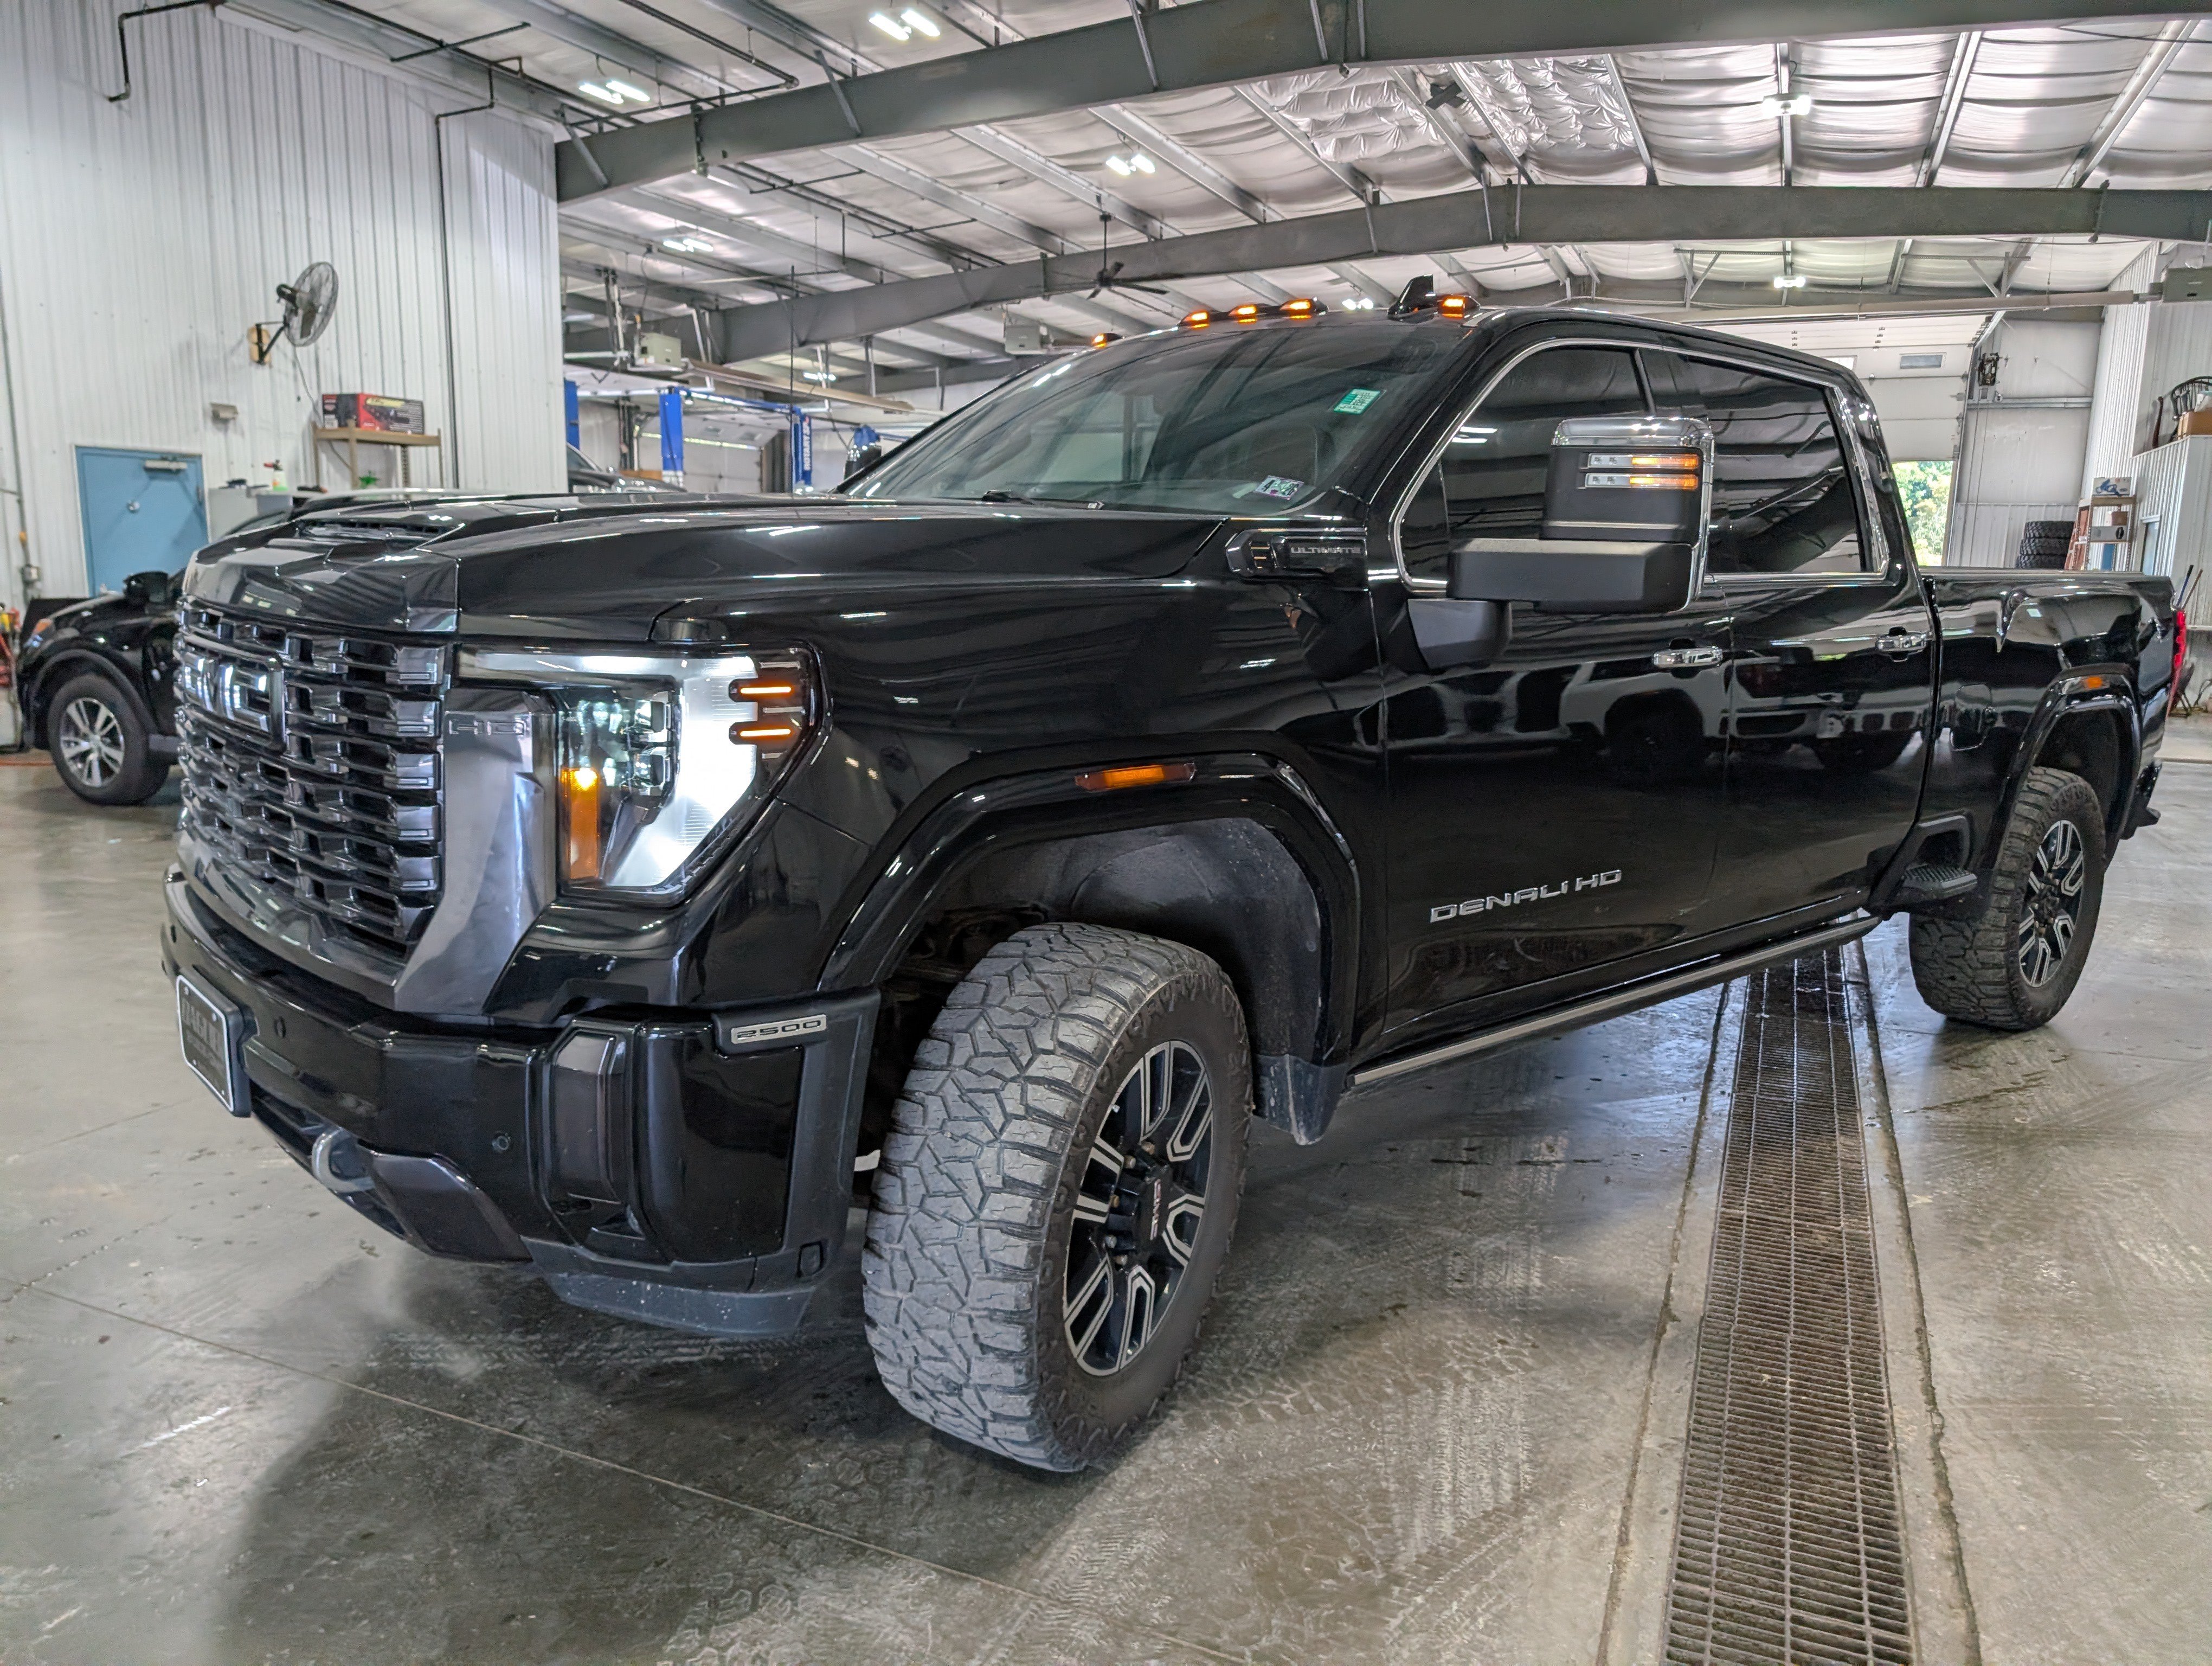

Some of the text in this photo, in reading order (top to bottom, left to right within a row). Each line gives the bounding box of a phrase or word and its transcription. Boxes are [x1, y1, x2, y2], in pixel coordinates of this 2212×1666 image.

[1290, 546, 1361, 554] ULTIMATE
[182, 651, 269, 733] GMC
[448, 717, 527, 736] HD
[1429, 869, 1622, 923] DENALI HD
[736, 1020, 821, 1041] 2500
[1149, 1178, 1161, 1241] GMC
